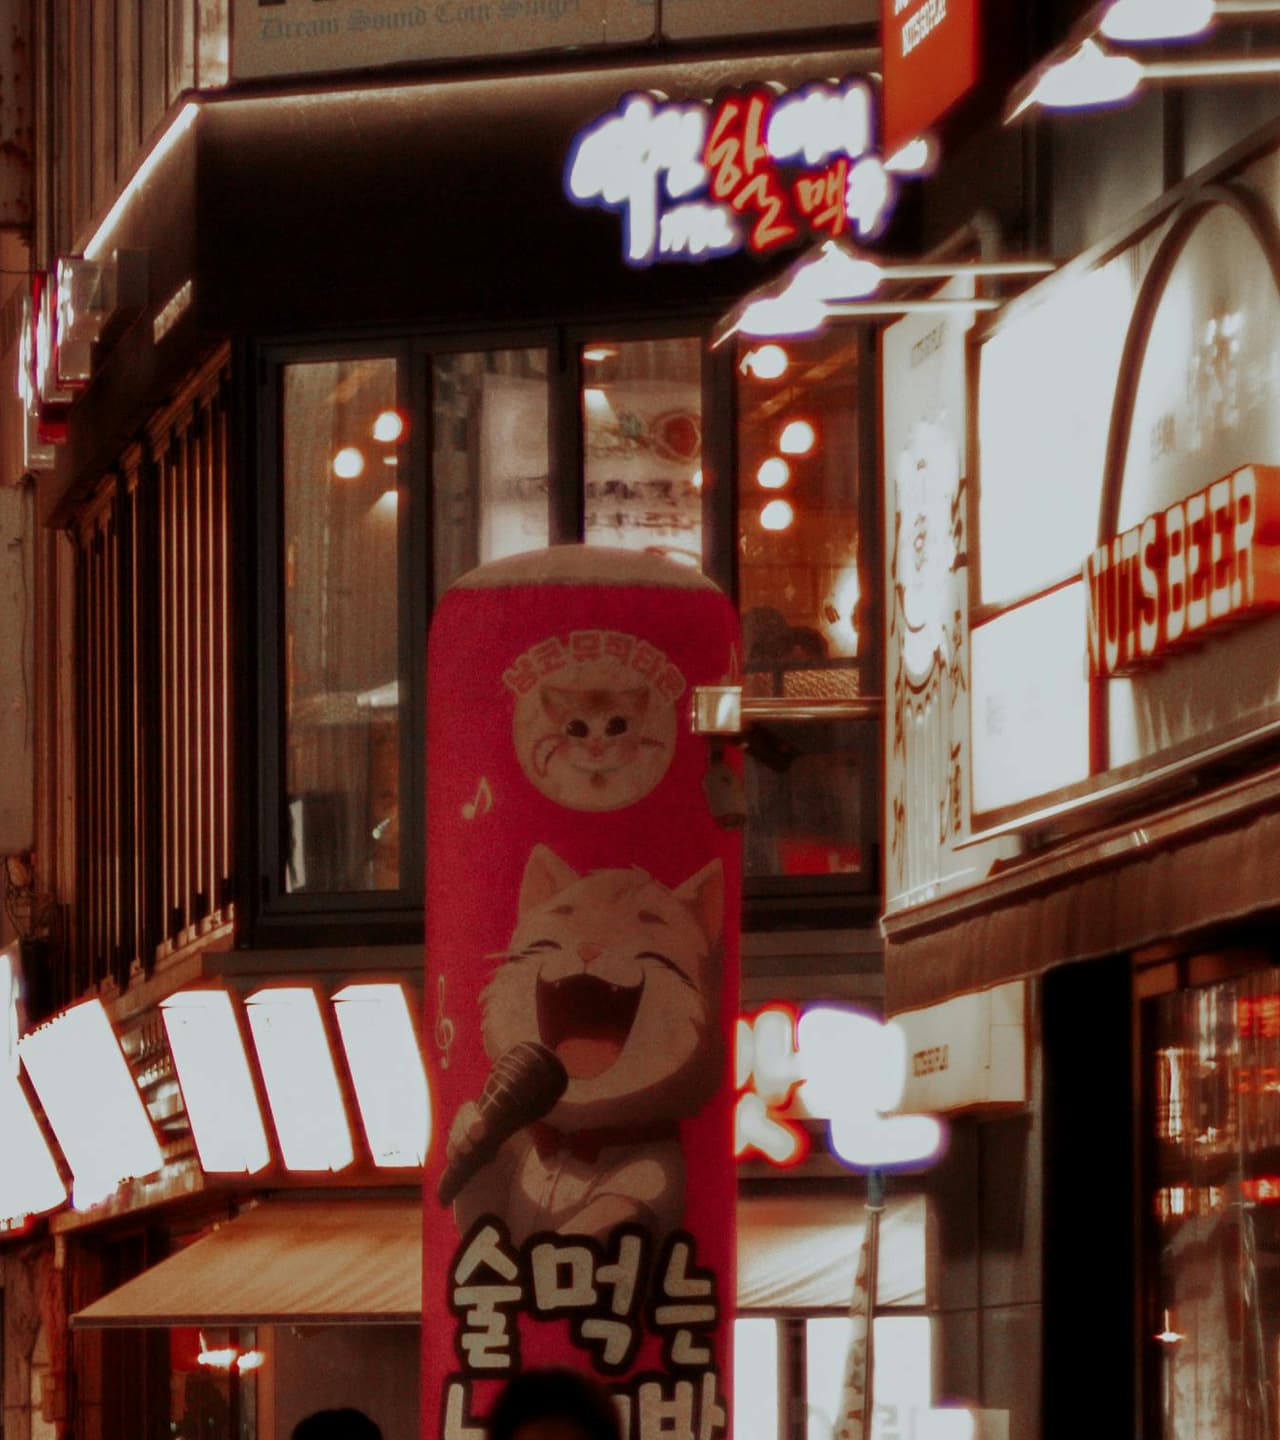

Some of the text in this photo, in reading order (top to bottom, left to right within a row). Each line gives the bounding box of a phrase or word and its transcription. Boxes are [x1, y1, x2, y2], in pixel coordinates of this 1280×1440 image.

[1087, 515, 1159, 676] NUTS
[1166, 462, 1256, 644] BEER
[452, 1224, 718, 1368] 술먹는
